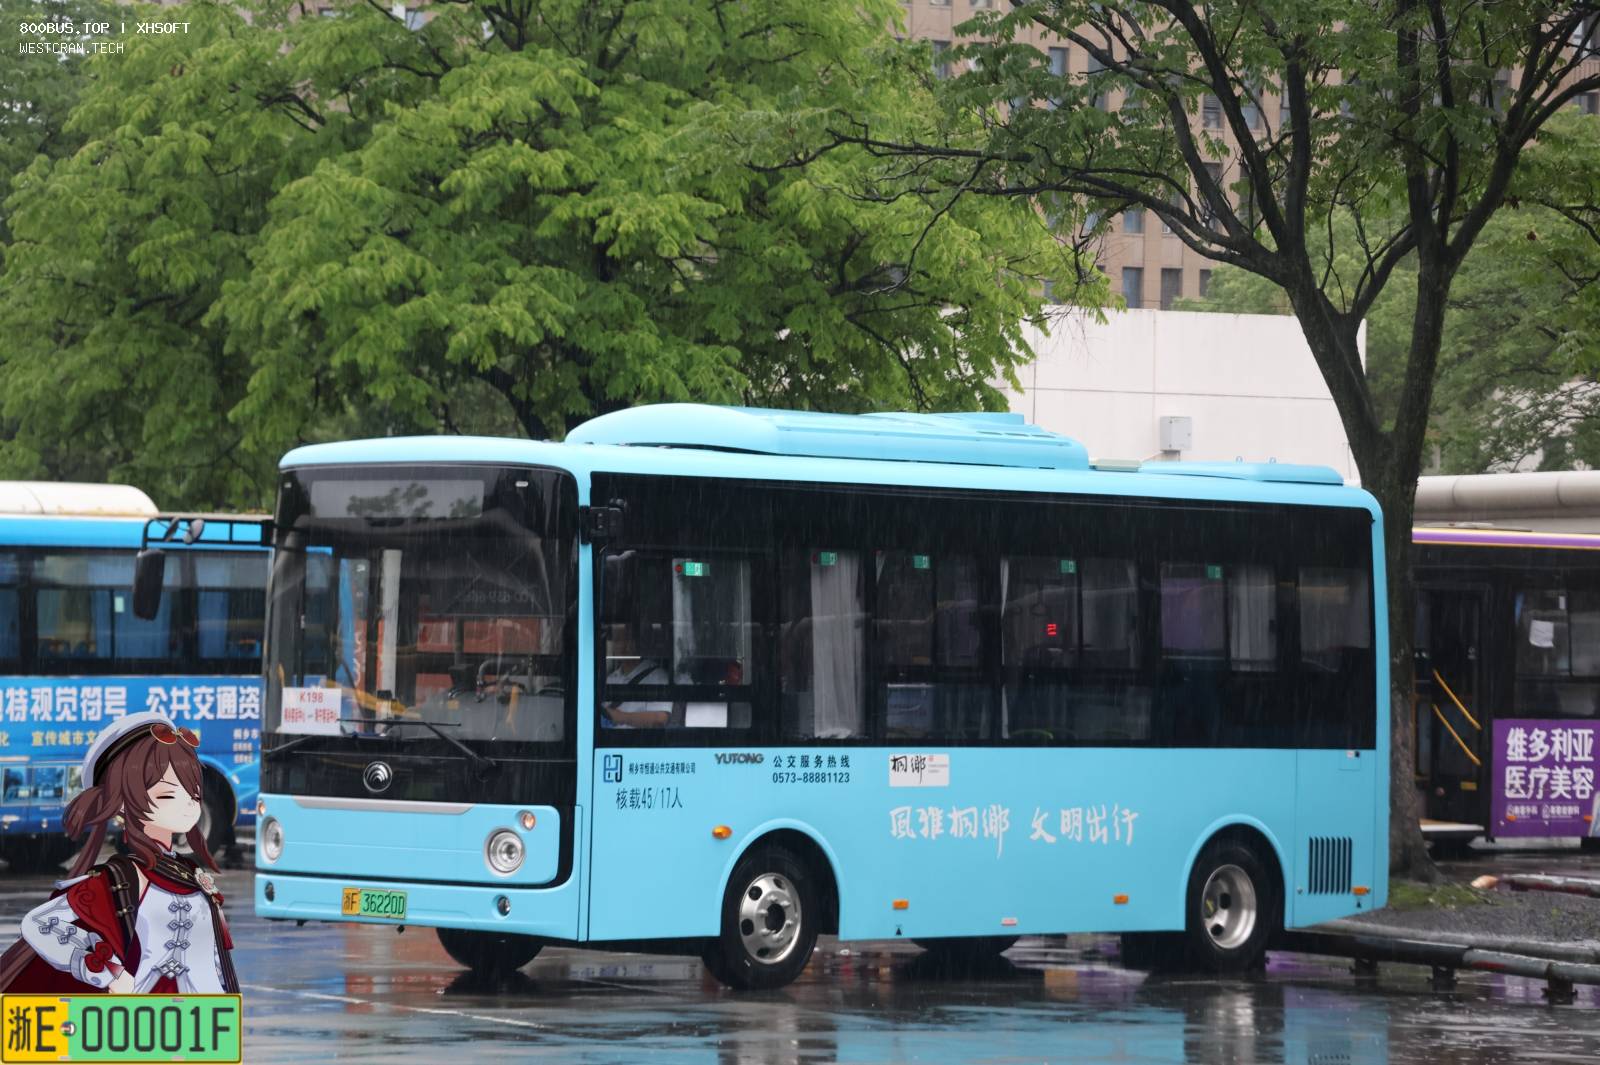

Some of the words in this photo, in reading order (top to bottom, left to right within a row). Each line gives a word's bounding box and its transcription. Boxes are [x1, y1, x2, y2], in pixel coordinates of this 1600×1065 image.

[0, 686, 127, 722] 特视觉符号
[299, 691, 324, 704] K198
[1506, 727, 1594, 763] 维多利亚
[714, 752, 765, 765] YUTONG
[773, 754, 851, 769] 公交服务热线
[772, 771, 851, 784] 0573-88881123
[1504, 764, 1594, 800] 医疗美容
[616, 787, 683, 810] 核载45/17人
